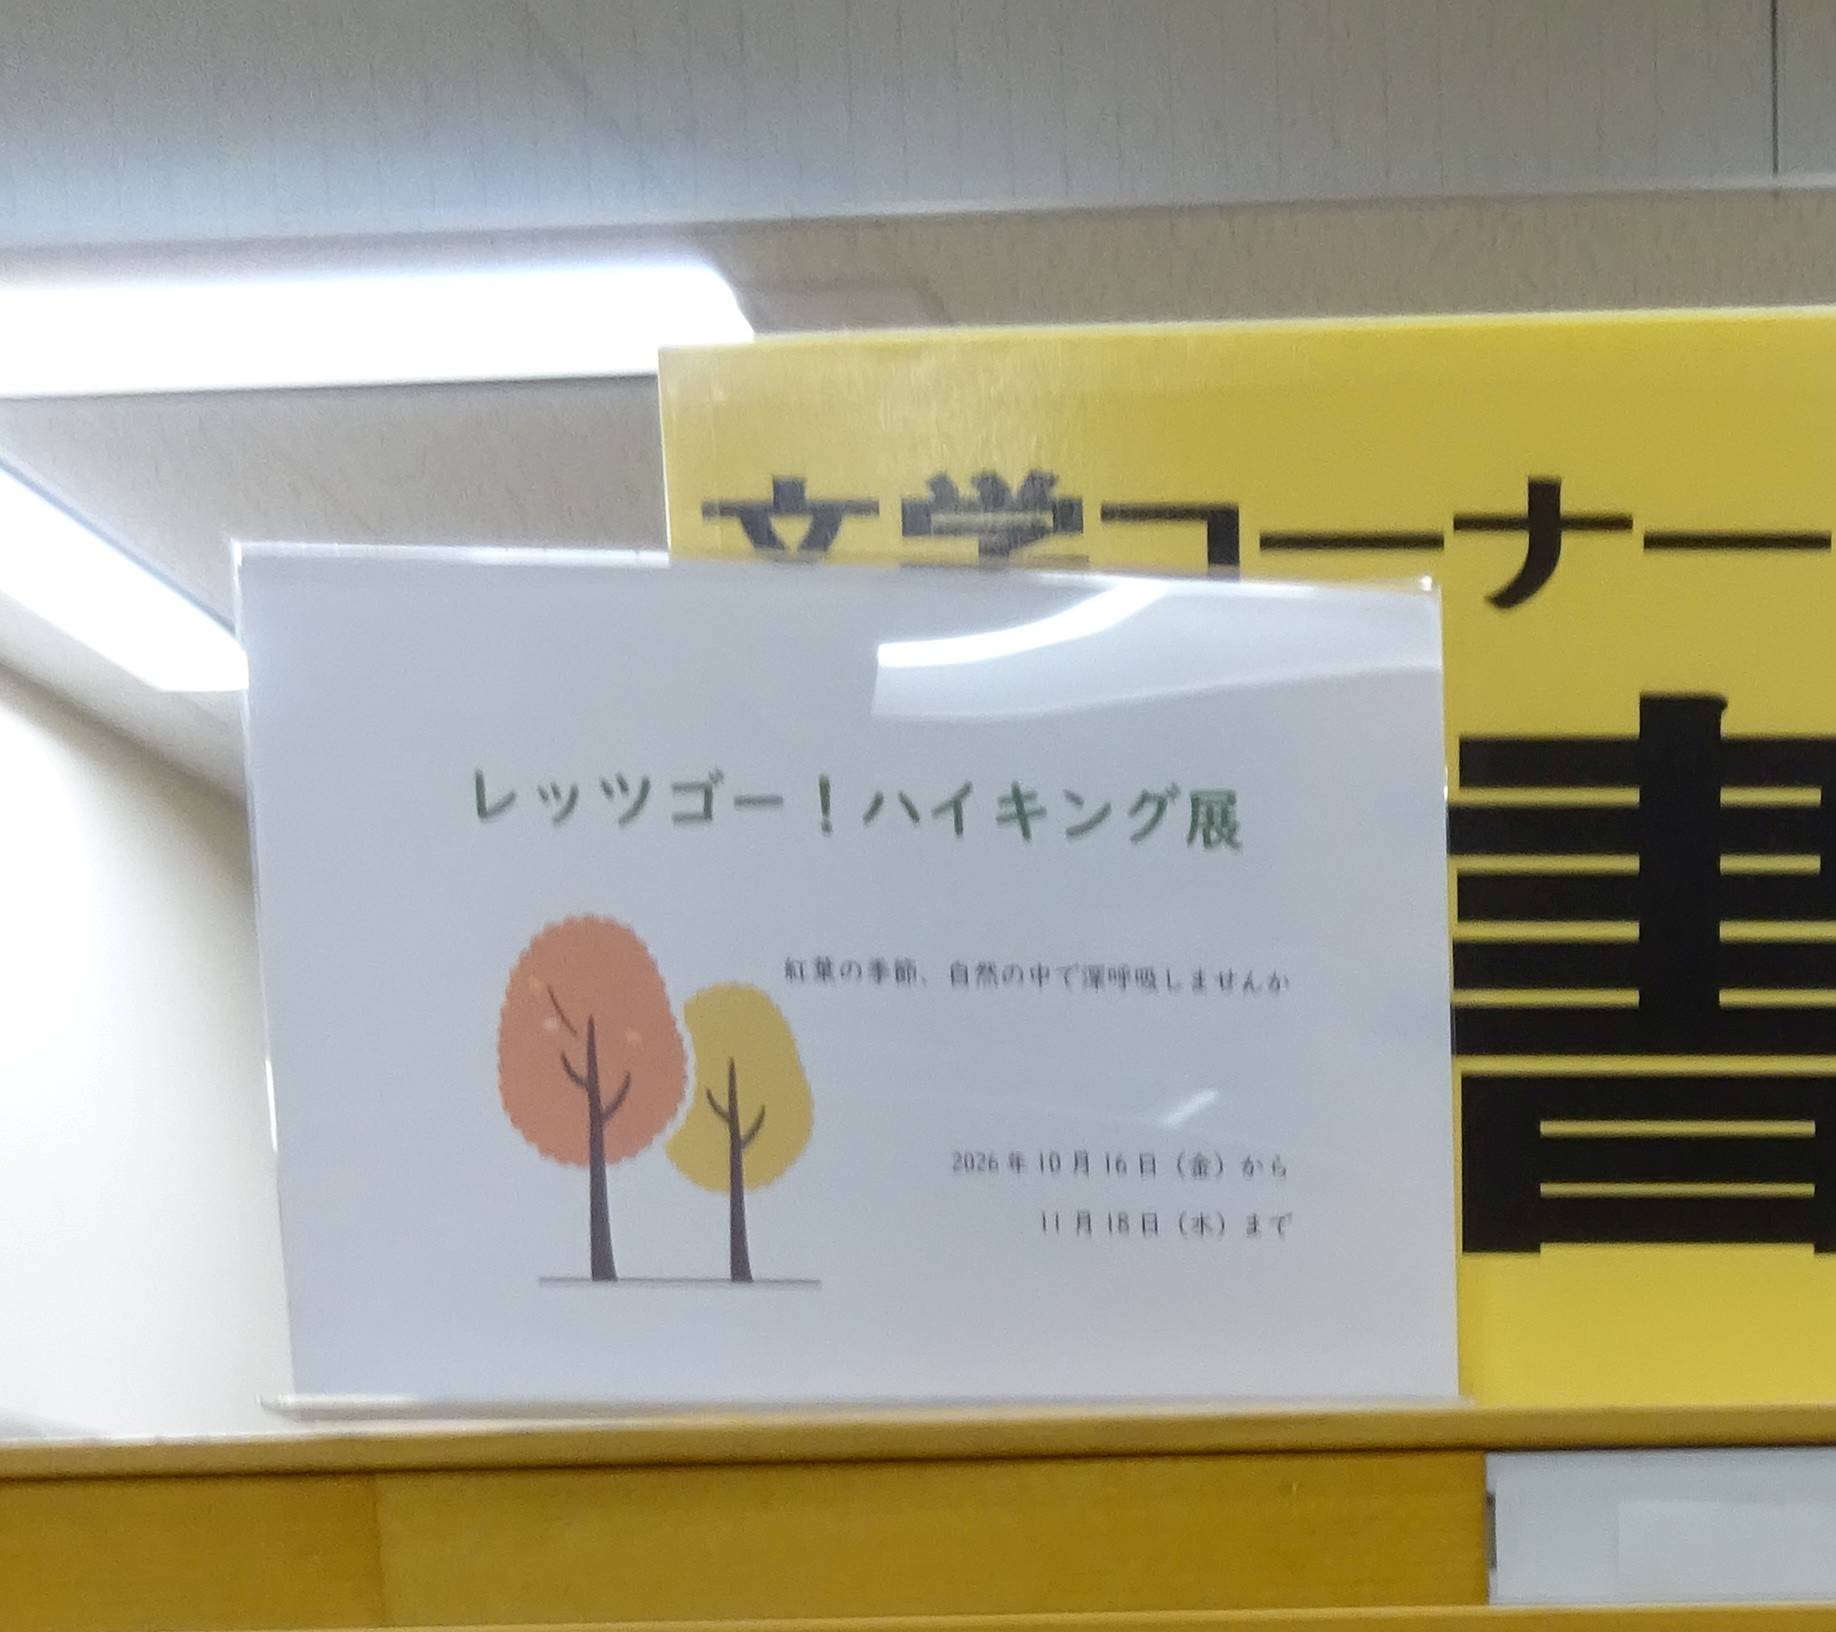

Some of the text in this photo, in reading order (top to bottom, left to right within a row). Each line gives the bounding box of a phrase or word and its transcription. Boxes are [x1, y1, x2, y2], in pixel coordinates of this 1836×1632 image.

[472, 768, 1245, 854] レッツゴー！ハイキング展
